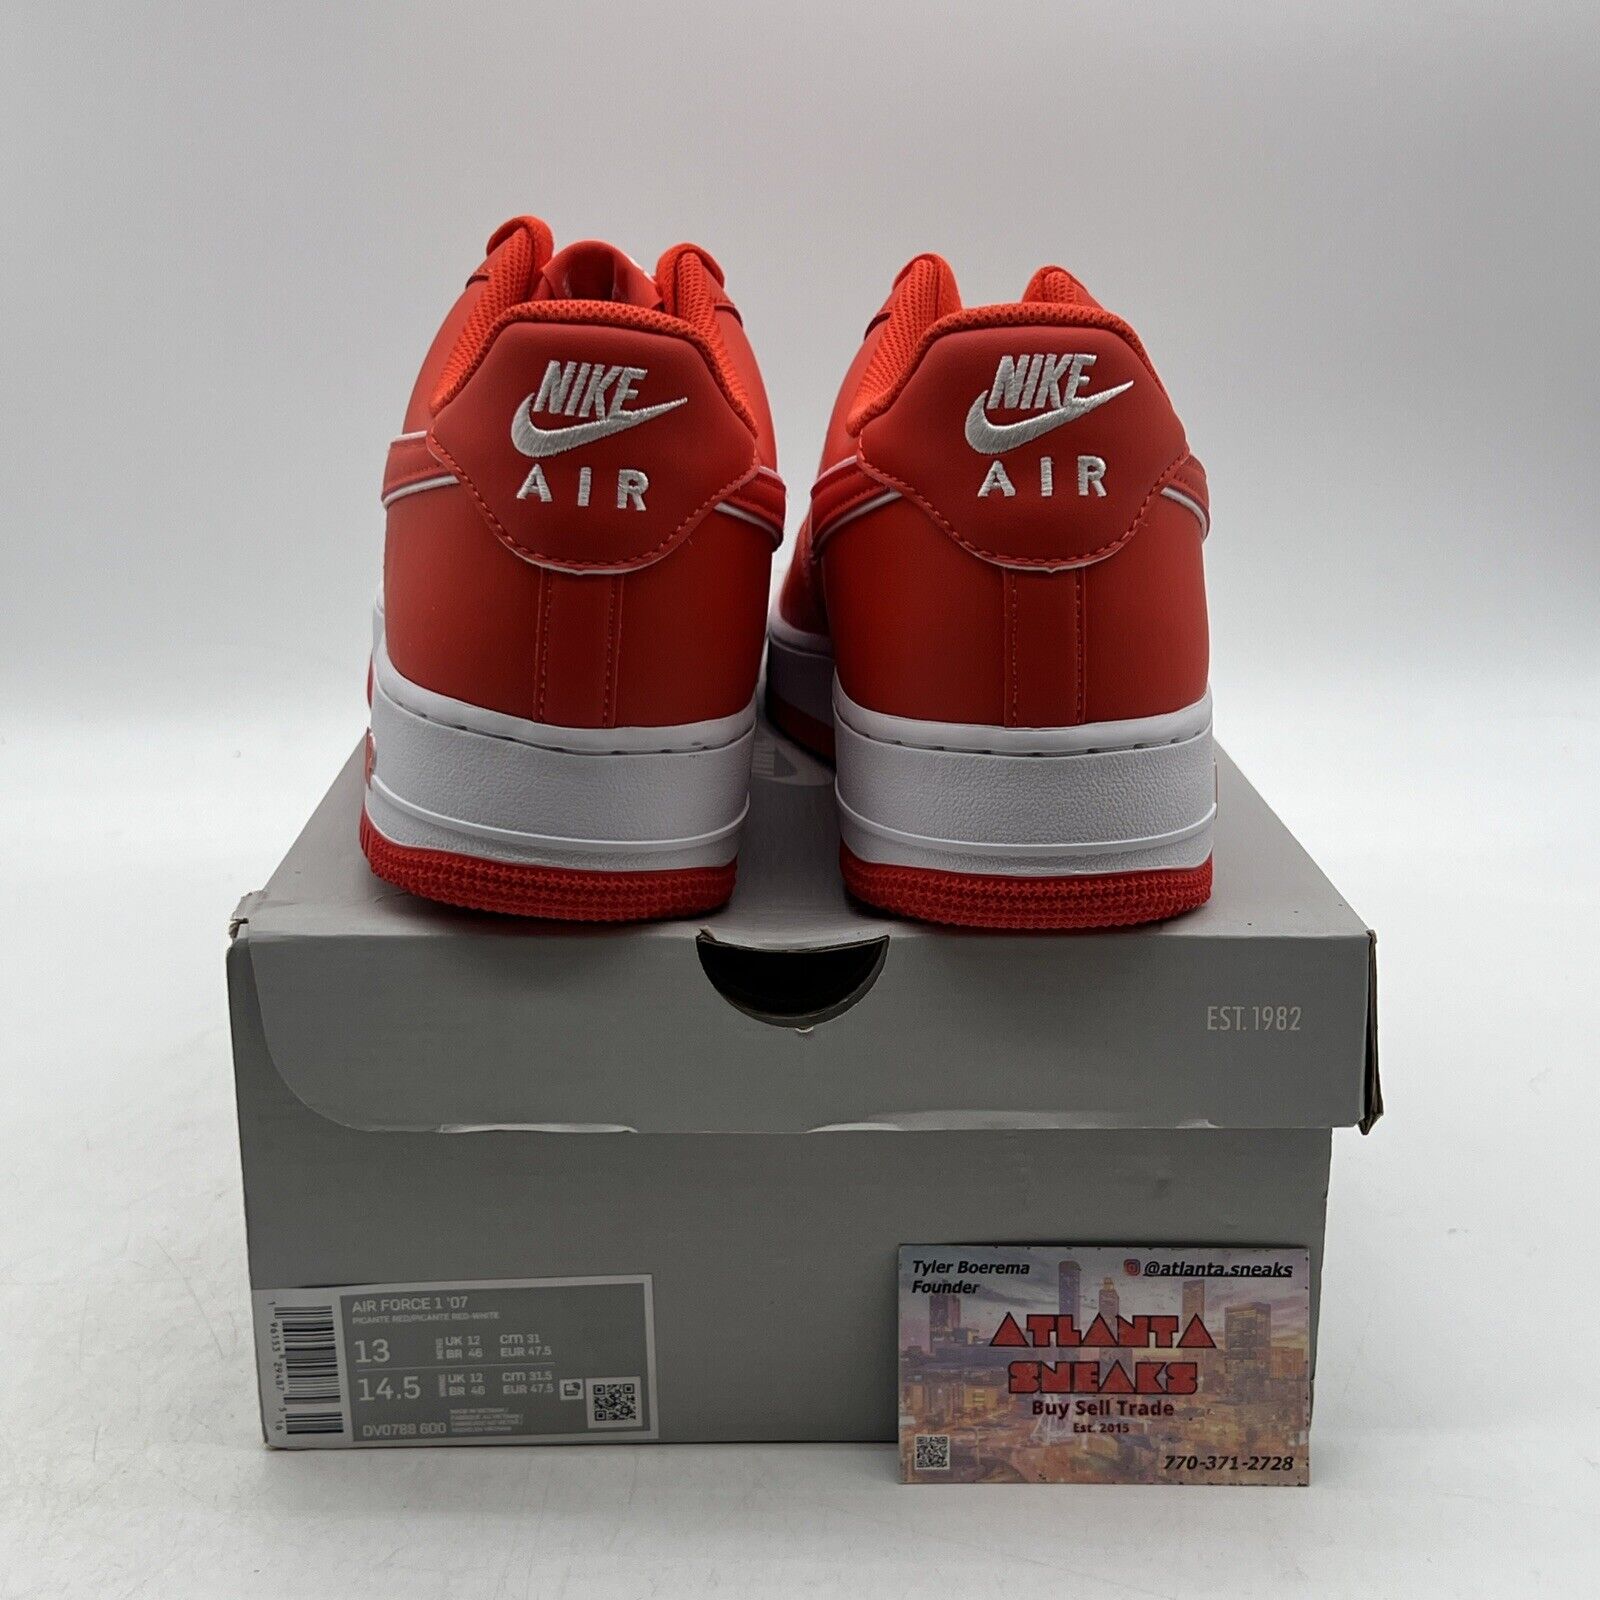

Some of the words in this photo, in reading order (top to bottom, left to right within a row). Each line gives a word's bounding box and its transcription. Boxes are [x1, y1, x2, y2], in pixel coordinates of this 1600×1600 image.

[533, 360, 648, 419] NIKE
[987, 353, 1097, 409] NIKE
[977, 455, 1107, 497] AIR
[517, 463, 649, 511] AIR
[913, 1260, 953, 1276] Tyler
[957, 1260, 1030, 1275] Boerema
[1143, 1259, 1294, 1278] @atlanta.sneaks
[912, 1280, 980, 1294] Founder
[352, 1300, 376, 1313] AIR
[381, 1297, 431, 1311] FORCE
[435, 1297, 442, 1308] 1
[447, 1295, 468, 1308] '07
[989, 1312, 1217, 1348] ATLANTA
[445, 1336, 463, 1347] UK
[467, 1335, 481, 1346] 12
[527, 1334, 541, 1344] 31
[354, 1338, 391, 1363] 13
[500, 1346, 525, 1357] EUR
[528, 1345, 552, 1356] 47.5
[448, 1373, 466, 1384] UK
[470, 1372, 484, 1383] 12
[529, 1370, 553, 1381] 31.5
[1008, 1359, 1199, 1395] SNEAKS
[357, 1375, 421, 1401] 14.5
[503, 1384, 528, 1395] EUR
[530, 1383, 554, 1393] 47.5
[1032, 1400, 1069, 1418] Buy
[1075, 1400, 1110, 1416] Sell
[1116, 1400, 1175, 1416] Trade
[420, 1422, 447, 1435] 600
[1073, 1422, 1096, 1434] Est.
[1100, 1422, 1130, 1434] 2015
[1164, 1455, 1295, 1472] 770-371-2728
